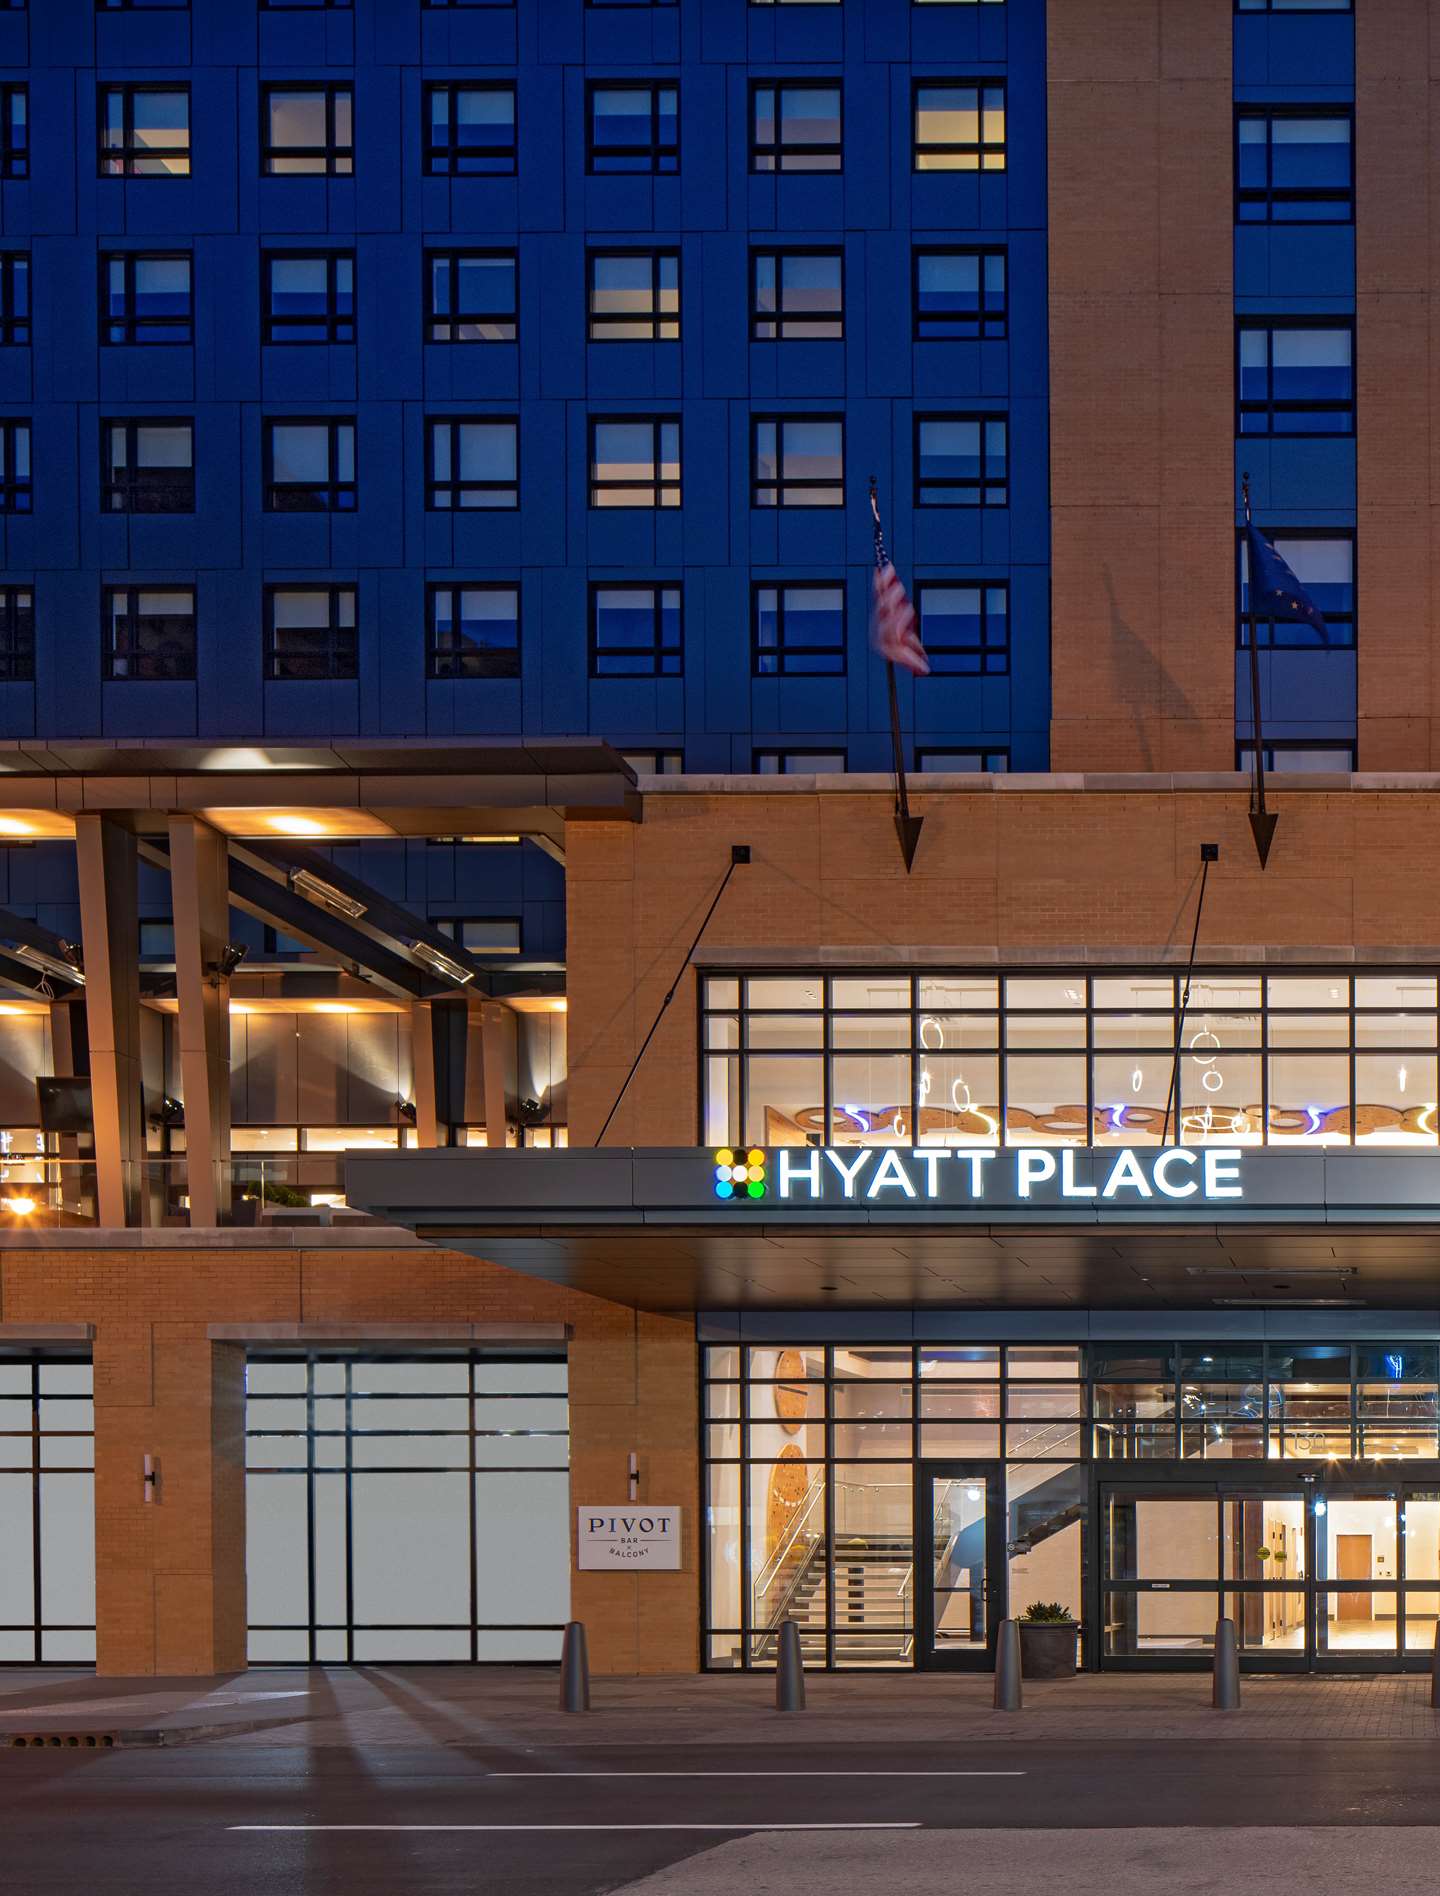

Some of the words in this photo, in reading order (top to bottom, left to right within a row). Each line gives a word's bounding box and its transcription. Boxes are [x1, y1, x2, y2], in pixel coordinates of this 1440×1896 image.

[780, 1149, 997, 1198] HYATT
[1017, 1149, 1243, 1198] PLACE
[588, 1517, 671, 1533] PIVOT
[608, 1547, 650, 1558] BALCONY
